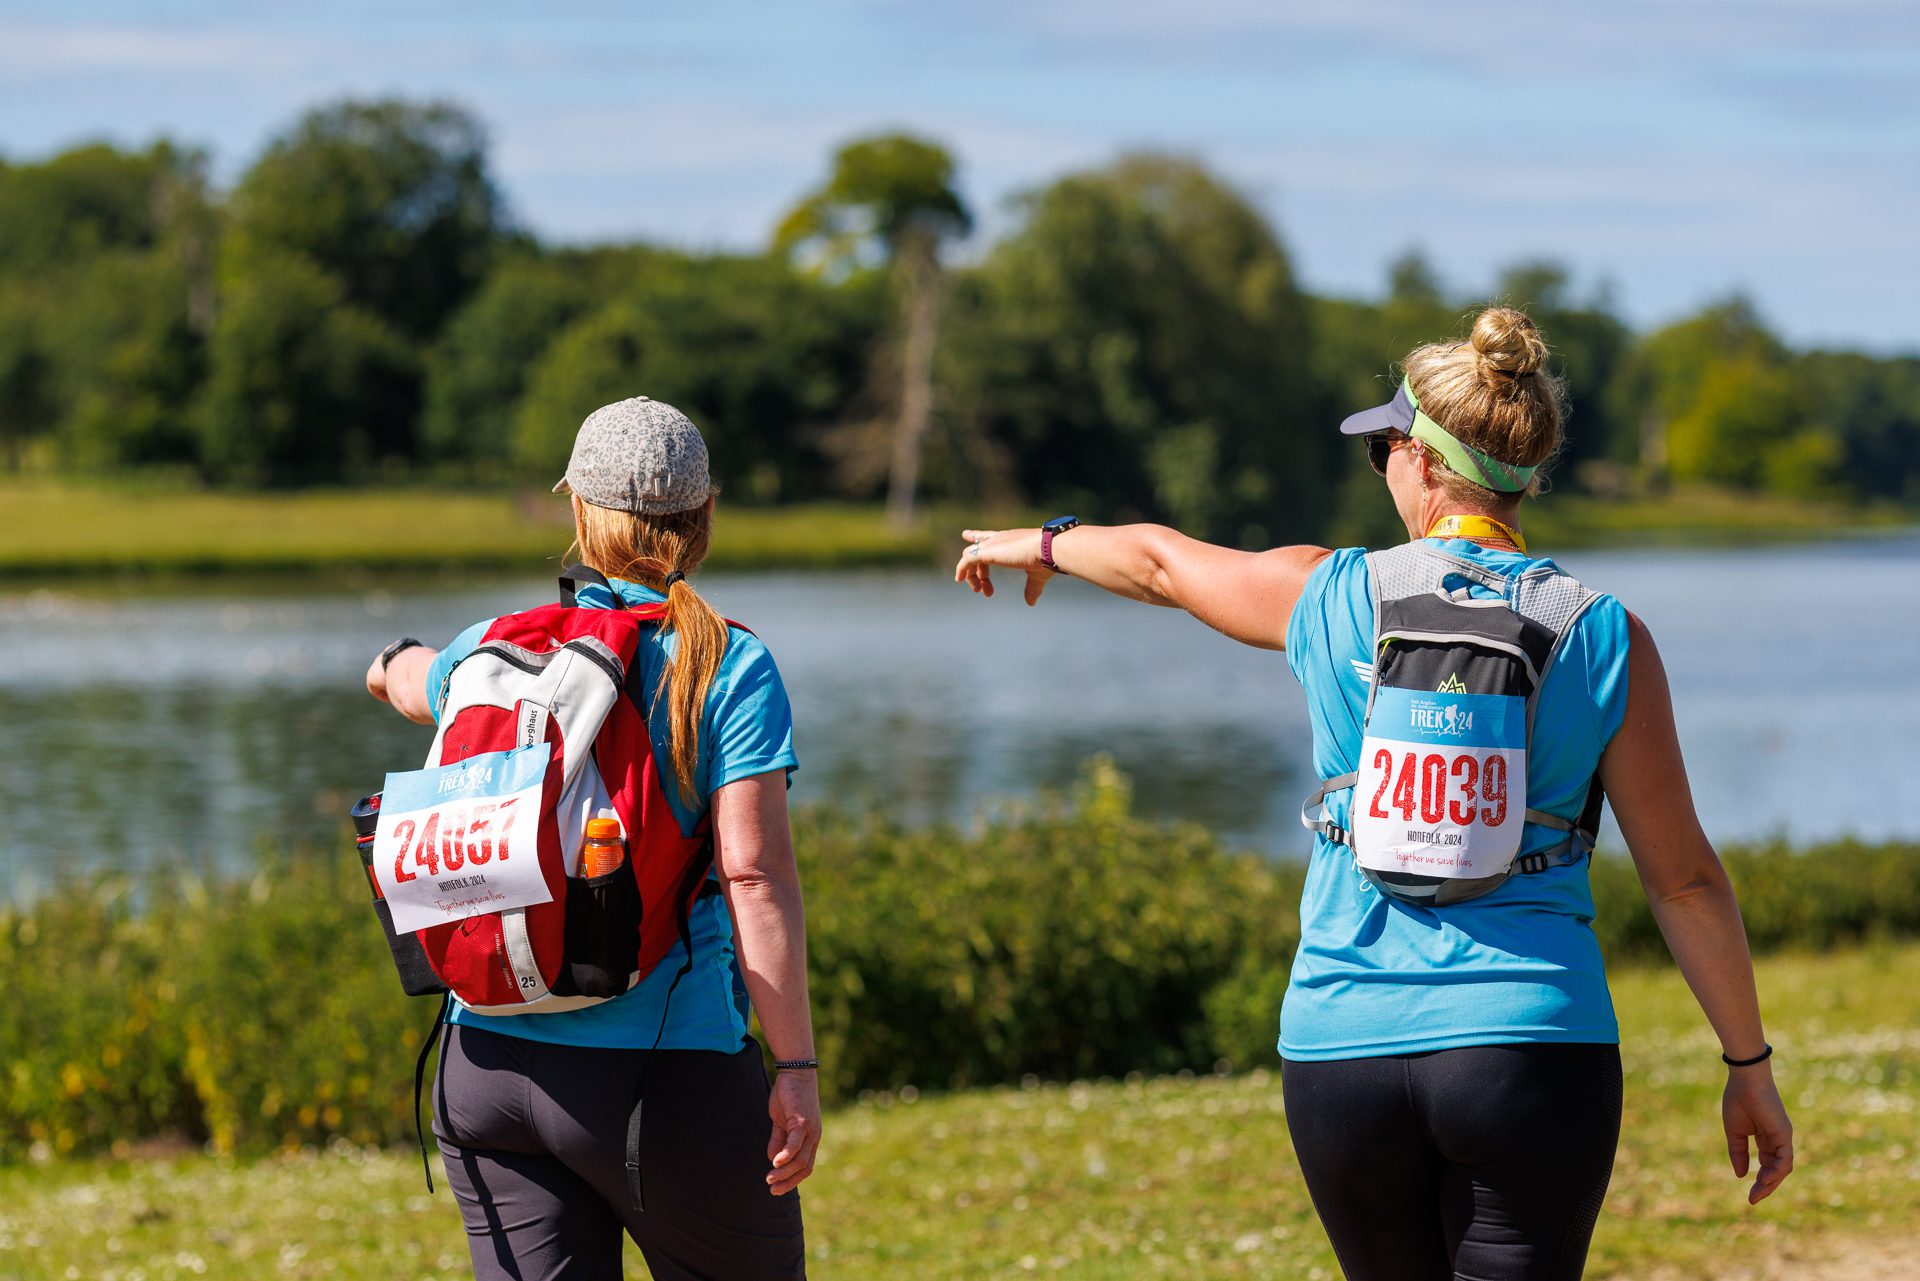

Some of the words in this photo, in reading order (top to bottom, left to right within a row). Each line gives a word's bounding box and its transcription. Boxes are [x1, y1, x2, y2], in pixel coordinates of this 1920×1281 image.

[526, 710, 538, 745] erghaus
[1410, 709, 1444, 729] TREK
[1458, 711, 1473, 730] 24
[438, 772, 467, 794] TREK
[478, 767, 493, 784] 24
[1369, 748, 1507, 827] 24039
[393, 797, 520, 884] 24057
[1407, 830, 1441, 844] NORFOLK
[1444, 834, 1462, 846] 2024
[1393, 848, 1424, 867] Together
[1425, 856, 1435, 864] we
[1436, 858, 1454, 866] save
[1455, 853, 1473, 868] lives
[438, 877, 470, 892] NORFOLK
[469, 874, 487, 885] 2024
[434, 895, 465, 916] Together
[521, 976, 536, 989] 25
